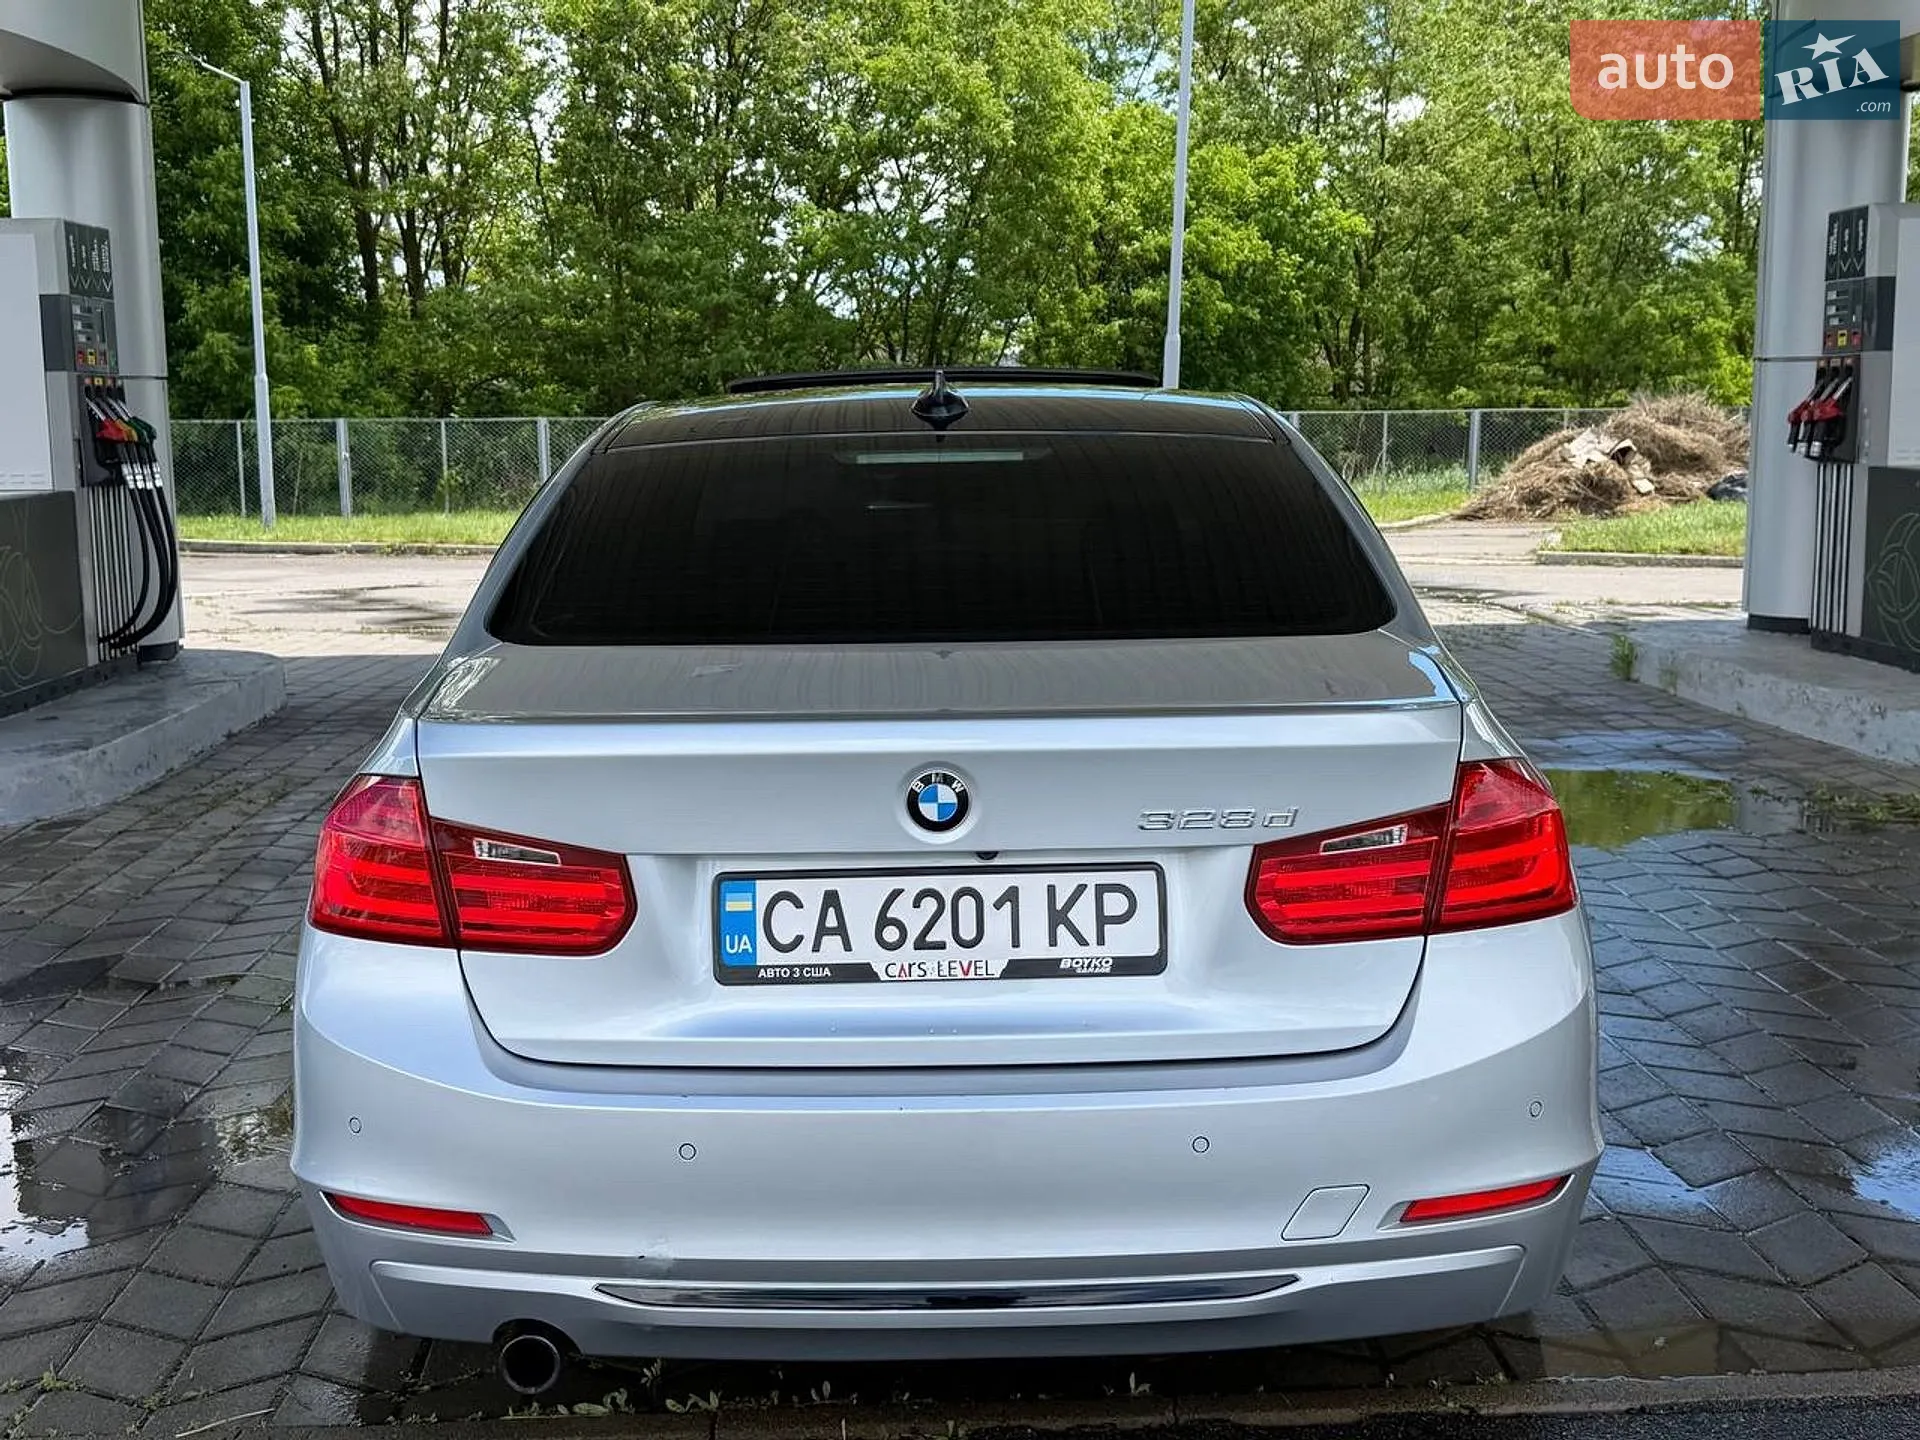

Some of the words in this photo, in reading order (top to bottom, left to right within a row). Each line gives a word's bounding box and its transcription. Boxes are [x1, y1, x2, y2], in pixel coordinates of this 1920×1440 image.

[1138, 805, 1300, 831] 328d
[762, 889, 853, 954] CA
[874, 885, 1020, 952] 6201
[1047, 883, 1138, 948] KP
[725, 934, 753, 954] UA
[757, 968, 790, 979] АВТО
[803, 966, 831, 978] США
[937, 959, 995, 977] LEVEL
[1060, 957, 1113, 969] BOYKO
